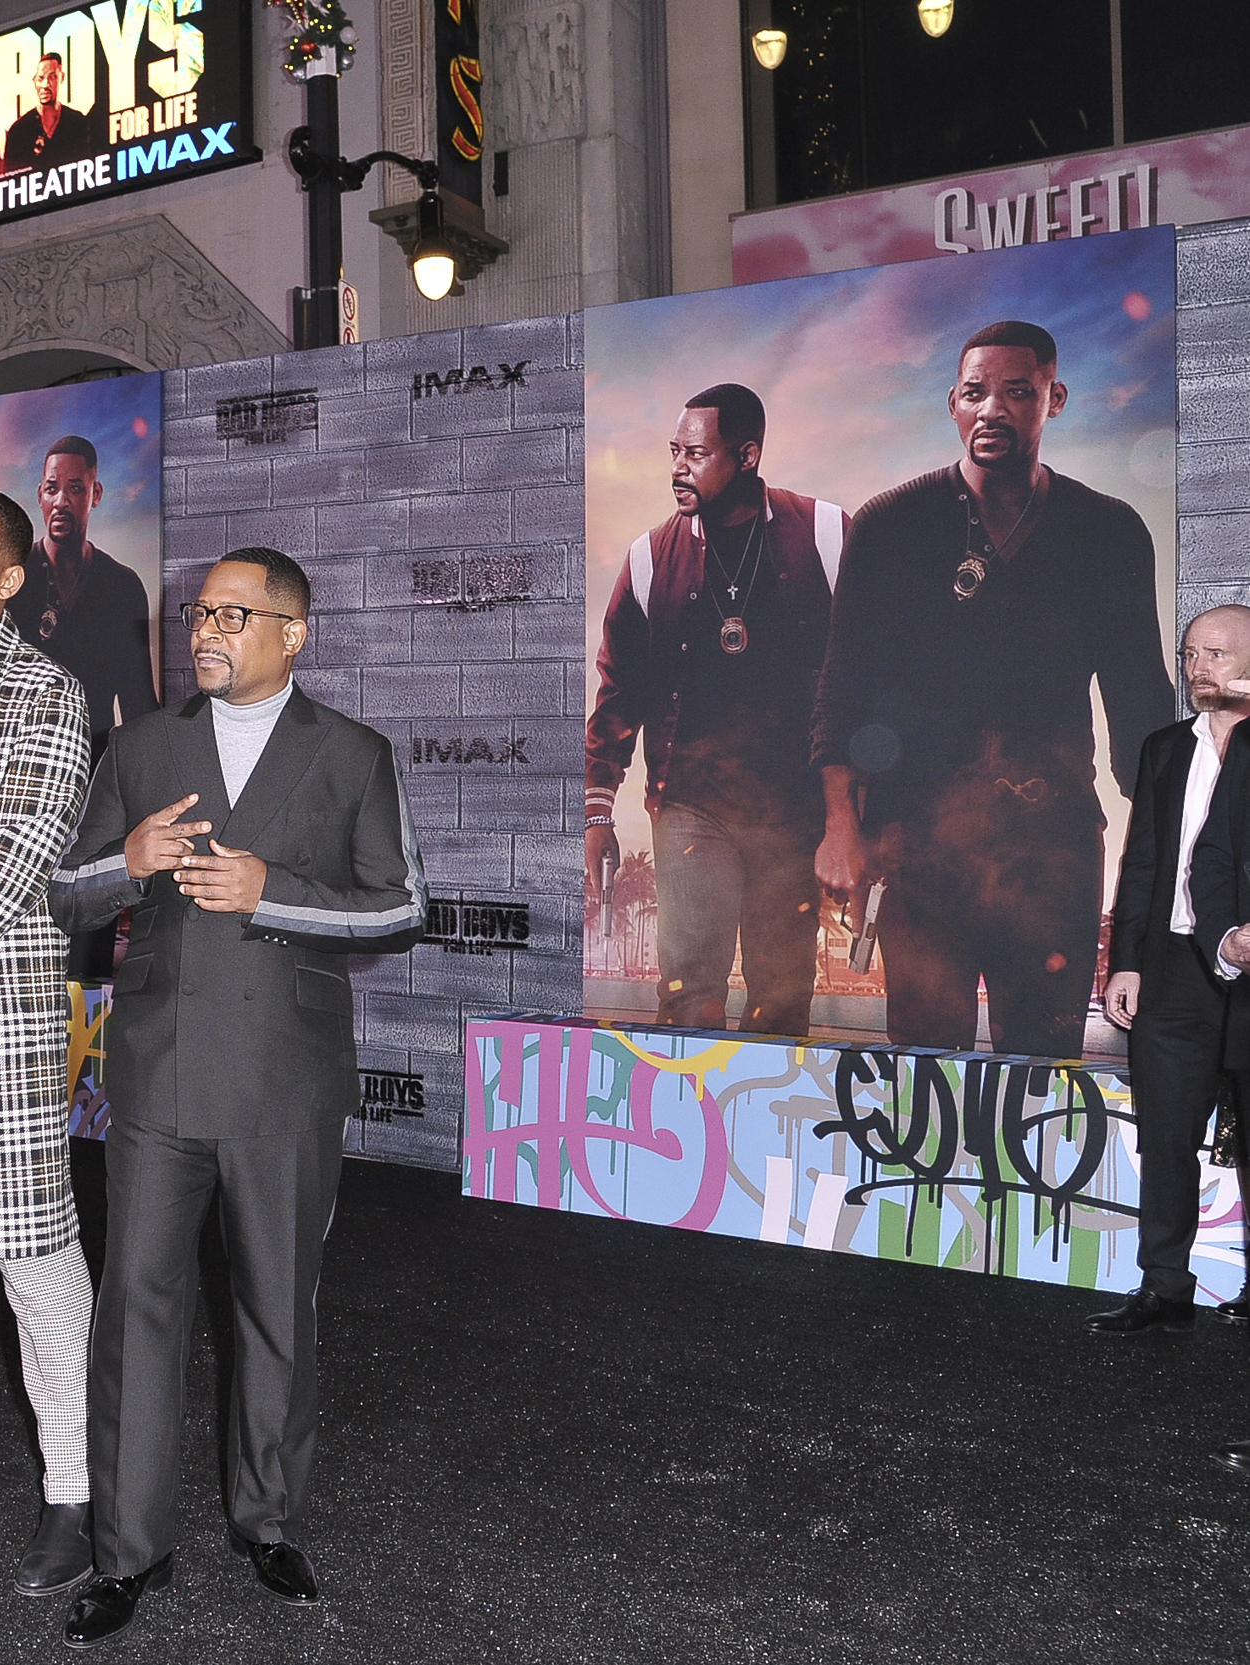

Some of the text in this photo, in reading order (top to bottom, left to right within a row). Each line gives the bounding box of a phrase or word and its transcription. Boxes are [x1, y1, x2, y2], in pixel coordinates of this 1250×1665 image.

[108, 91, 198, 144] FOR LIFE
[116, 121, 236, 182] IMAX
[412, 360, 531, 400] IMAX
[412, 737, 531, 765] IMAX
[426, 905, 530, 941] AD BOYS
[364, 1076, 425, 1109] BOYS
[369, 1106, 393, 1122] LIFE
